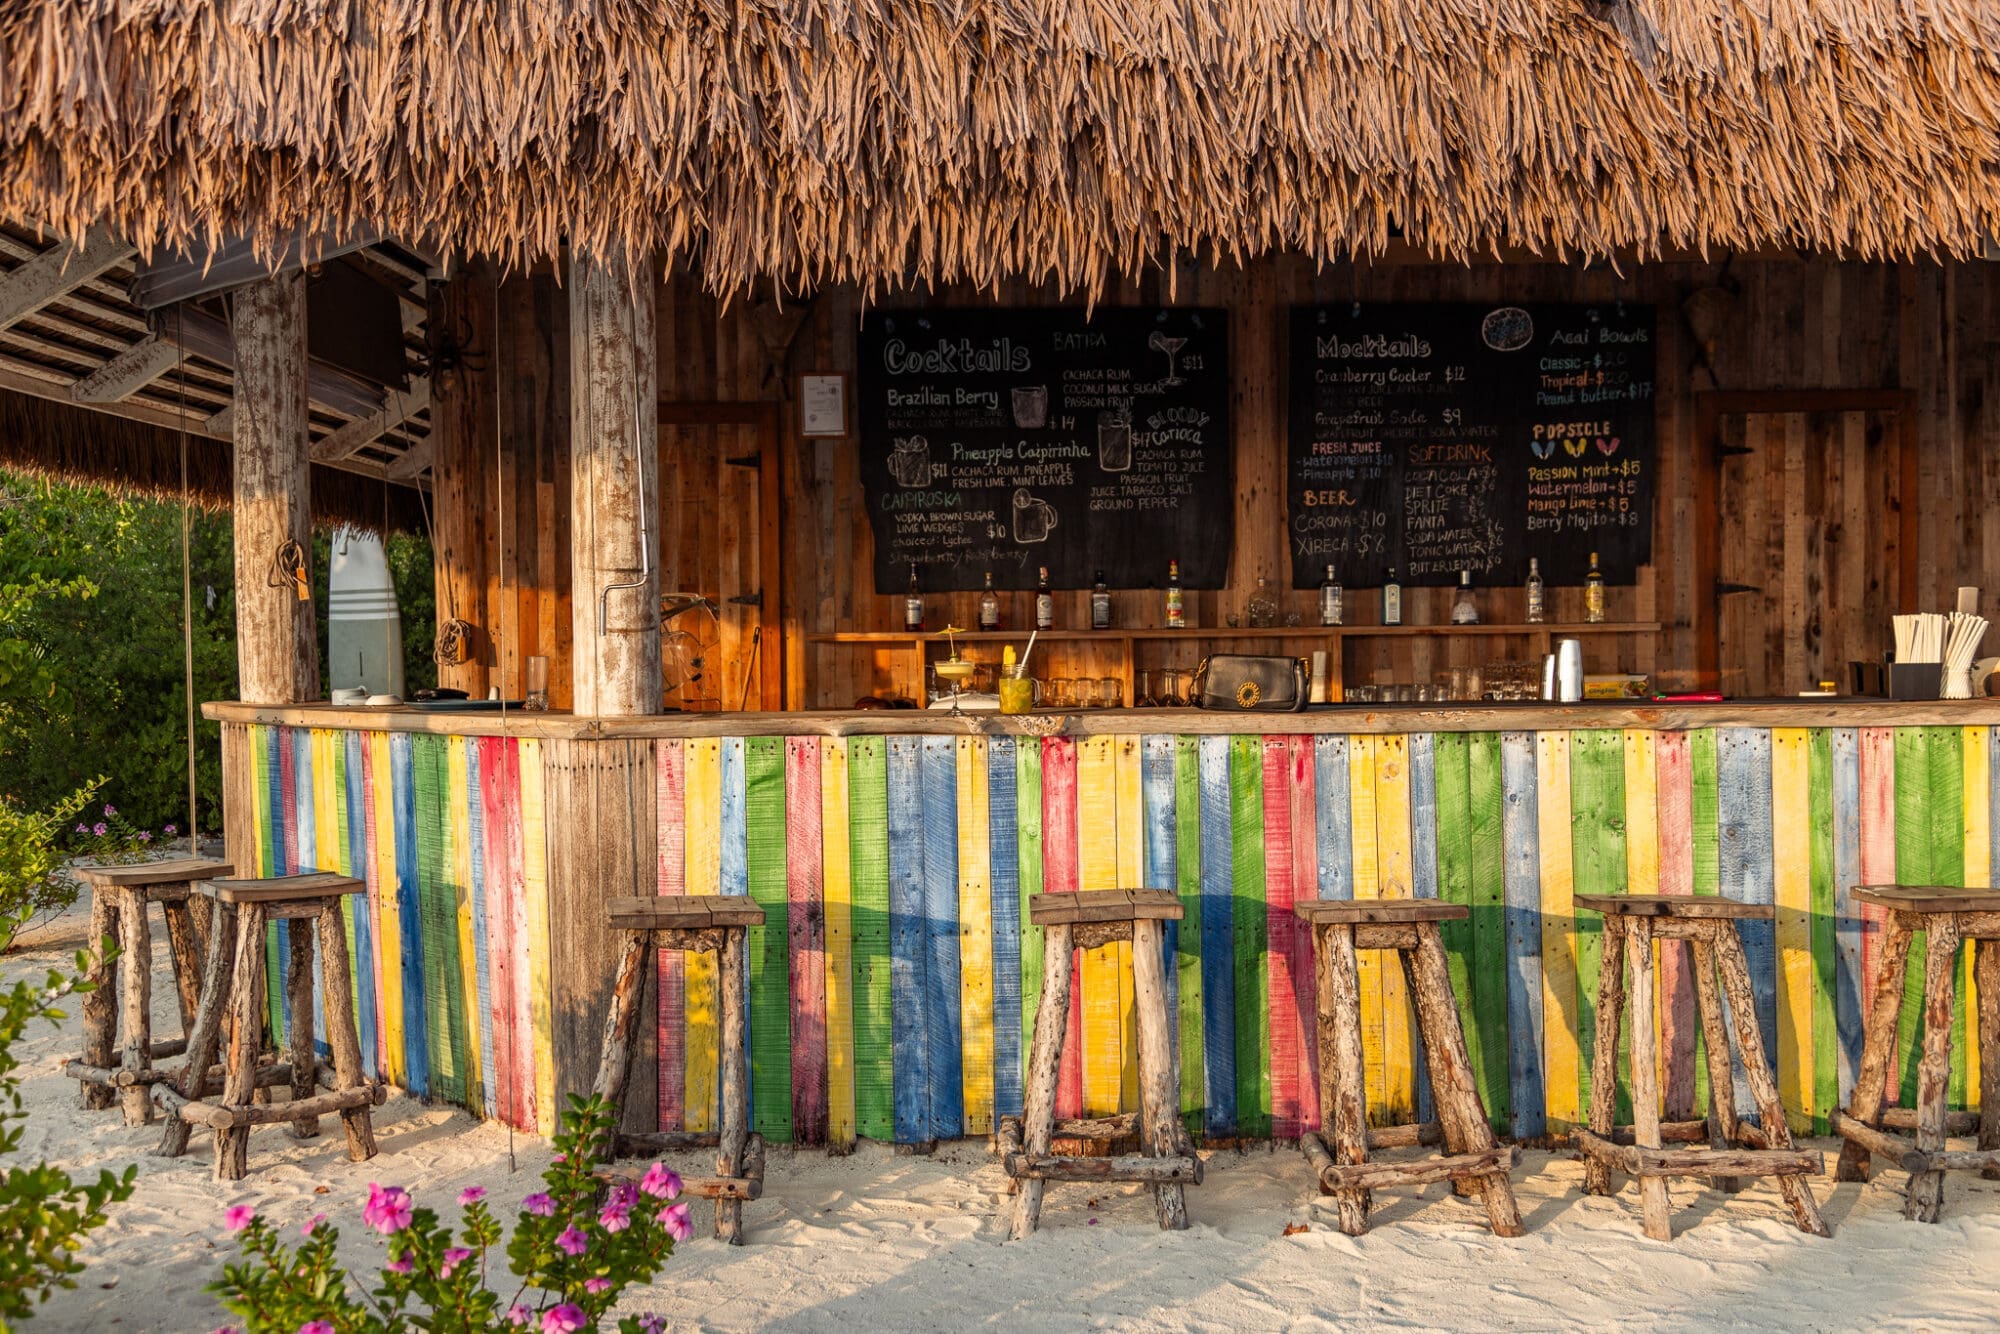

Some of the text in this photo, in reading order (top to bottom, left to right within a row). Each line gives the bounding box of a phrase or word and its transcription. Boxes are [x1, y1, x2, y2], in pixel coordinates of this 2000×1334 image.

[1599, 326, 1650, 344] Bowls
[1316, 333, 1432, 359] Mocktails
[884, 337, 1031, 375] Cocktails
[1540, 355, 1582, 371] Classic
[1062, 368, 1131, 382] CACHACA RUM
[1315, 365, 1466, 386] Cranberry Cooler $12
[1539, 369, 1588, 393] Tropical
[888, 385, 999, 410] Brazilian Berry
[1063, 383, 1167, 396] COCONUT MILK SUGAR
[1536, 387, 1576, 406] Peanut
[1064, 396, 1135, 409] PASSION FRUIT
[1313, 408, 1462, 429] Grapefruit Soda $9
[1531, 420, 1612, 441] POPSICLE
[951, 440, 1091, 466] Pineapple Caipirinha
[1311, 441, 1382, 455] FRESH JUICE
[1408, 442, 1494, 464] SOFT DRINK
[951, 466, 994, 478] CACHACA
[1137, 461, 1176, 473] TOMATO
[1620, 458, 1641, 478] $5
[952, 477, 983, 489] FRESH
[1012, 474, 1036, 487] MINT
[1039, 473, 1074, 487] LEAVES
[1120, 473, 1190, 484] PASSION FRUIT
[1528, 477, 1608, 496] Watermelon
[1121, 485, 1165, 496] TABASCO
[1169, 483, 1194, 495] SALT
[1303, 489, 1357, 507] BEER
[1405, 485, 1431, 500] DIET
[881, 490, 963, 511] CAIPIROSKA
[1089, 497, 1178, 511] GROUND PEPPER
[1404, 499, 1449, 517] SPRITE
[1527, 497, 1567, 517] Mango
[929, 511, 962, 523] BROWN
[963, 509, 996, 522] SUGAR
[1295, 514, 1351, 532] CORONA
[1407, 514, 1446, 530] FANTA
[1527, 514, 1563, 532] Berry
[1566, 510, 1608, 531] Mojito
[1618, 510, 1639, 527] $8
[896, 521, 964, 535] LIME WEDGES
[1404, 531, 1435, 546] SODA
[1437, 527, 1477, 543] WATER
[1296, 537, 1349, 556] XIBECA
[1410, 545, 1443, 559] TONIC
[1445, 541, 1486, 556] WATER
